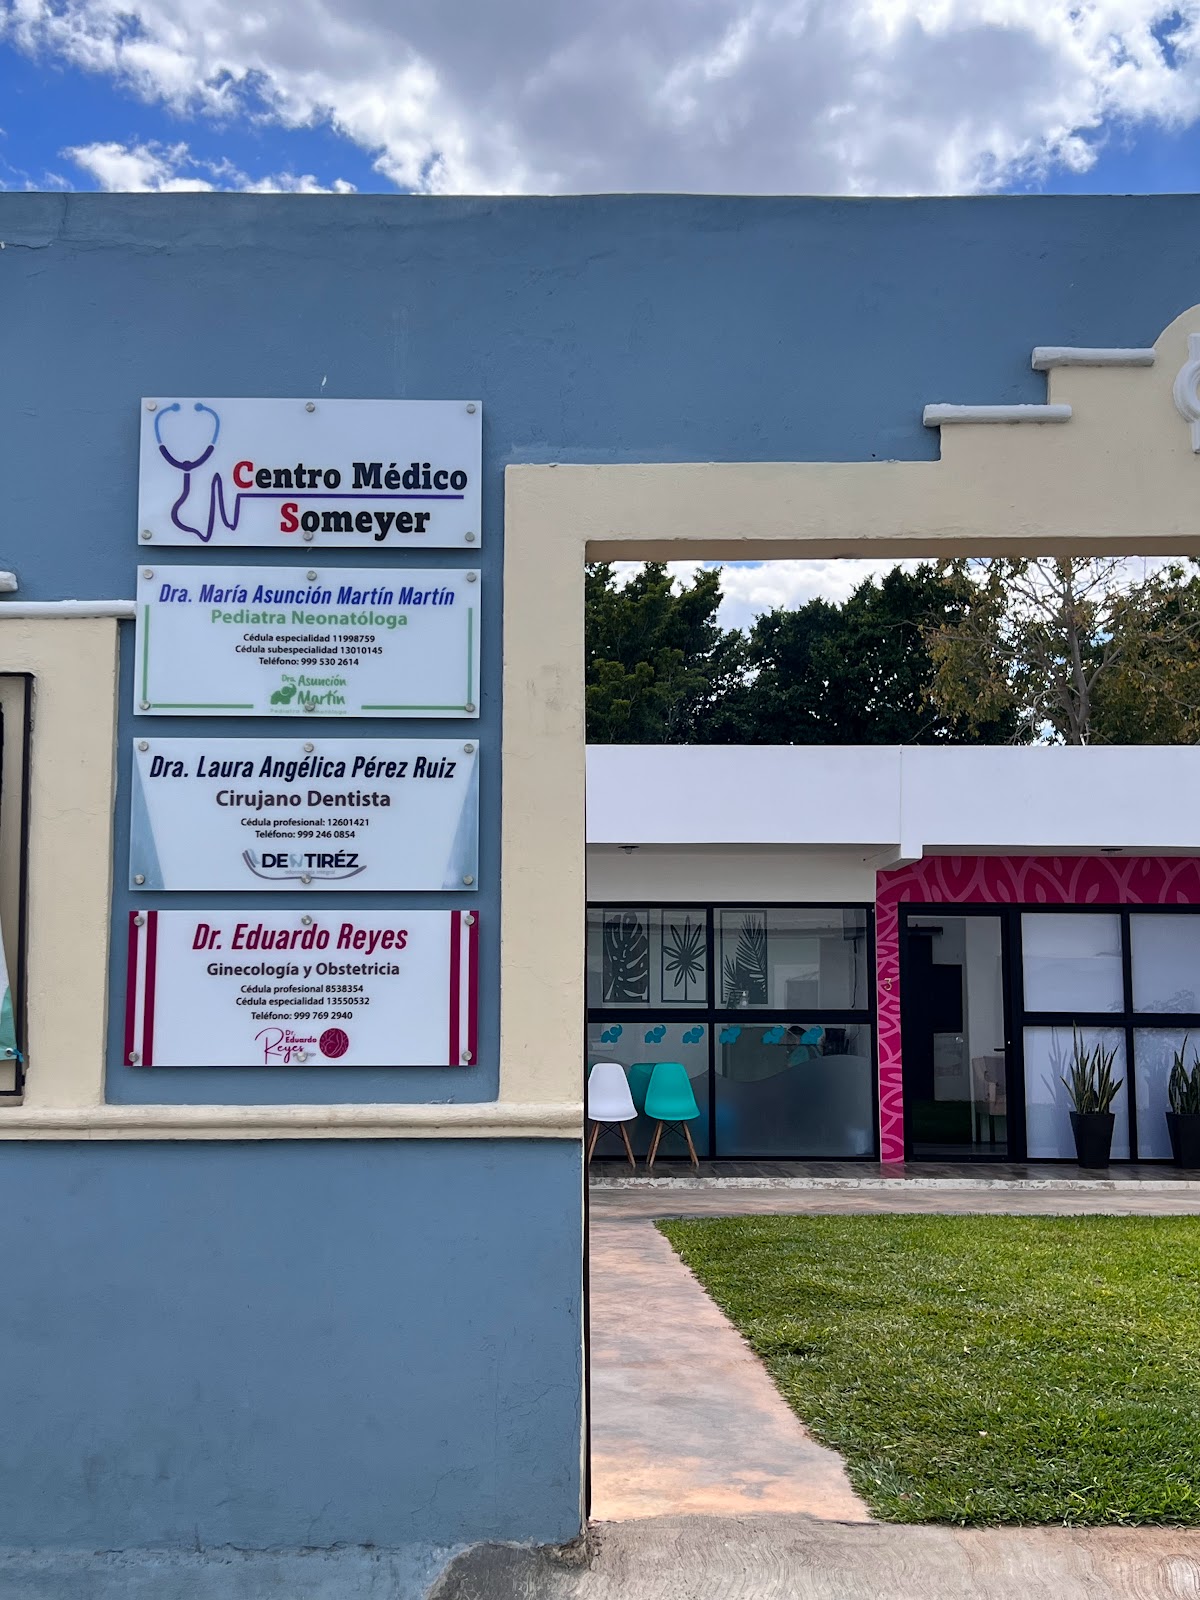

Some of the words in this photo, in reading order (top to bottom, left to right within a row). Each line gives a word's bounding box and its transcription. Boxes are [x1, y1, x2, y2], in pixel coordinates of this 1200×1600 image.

[233, 461, 341, 489] Centro
[352, 463, 468, 490] Médico
[280, 503, 431, 541] Someyer
[159, 584, 192, 603] Dra.
[199, 584, 248, 604] María
[252, 585, 332, 605] Asunción
[336, 586, 394, 606] Martín
[398, 587, 455, 606] Martín
[211, 609, 286, 625] Pediatra
[291, 610, 408, 629] Neonatóloga
[243, 633, 274, 643] Cédula
[275, 634, 331, 644] especialidad
[333, 635, 376, 643] 11998759
[235, 644, 266, 654] Cédula
[267, 645, 338, 656] subespecialidad
[340, 646, 383, 655] 13010145
[258, 657, 300, 666] Teléfono:
[300, 658, 317, 666] 999
[319, 658, 336, 666] 530
[337, 658, 359, 666] 2614
[298, 674, 347, 687] Asunción
[297, 690, 346, 705] Martín
[150, 755, 189, 778] Dra.
[196, 756, 253, 778] Laura
[258, 755, 346, 783] Angélica
[351, 756, 408, 779] Pérez
[412, 757, 457, 779] Ruiz
[215, 789, 302, 811] Cirujano
[307, 790, 391, 808] Dentista
[240, 818, 271, 827] Cédula
[273, 818, 325, 828] profesional:
[327, 819, 369, 827] 12601421
[255, 830, 296, 839] Teléfono:
[297, 831, 314, 839] 999
[315, 831, 332, 839] 246
[333, 831, 356, 839] 0854
[192, 924, 222, 950] Dr.
[231, 924, 331, 950] Eduardo
[336, 924, 409, 956] Reyes
[206, 961, 300, 979] Ginecología
[302, 966, 312, 979] y
[315, 962, 400, 977] Obstetricia
[240, 984, 272, 994] Cédula
[273, 984, 324, 995] profesional
[325, 985, 364, 993] 8538354
[884, 977, 893, 991] 3
[235, 996, 267, 1006] Cédula
[268, 997, 325, 1007] especialidad
[327, 997, 370, 1006] 13550532
[251, 1011, 292, 1021] Teléfono:
[293, 1012, 311, 1020] 999
[312, 1012, 329, 1020] 769
[330, 1012, 353, 1020] 2940
[254, 1027, 304, 1065] Reyes
